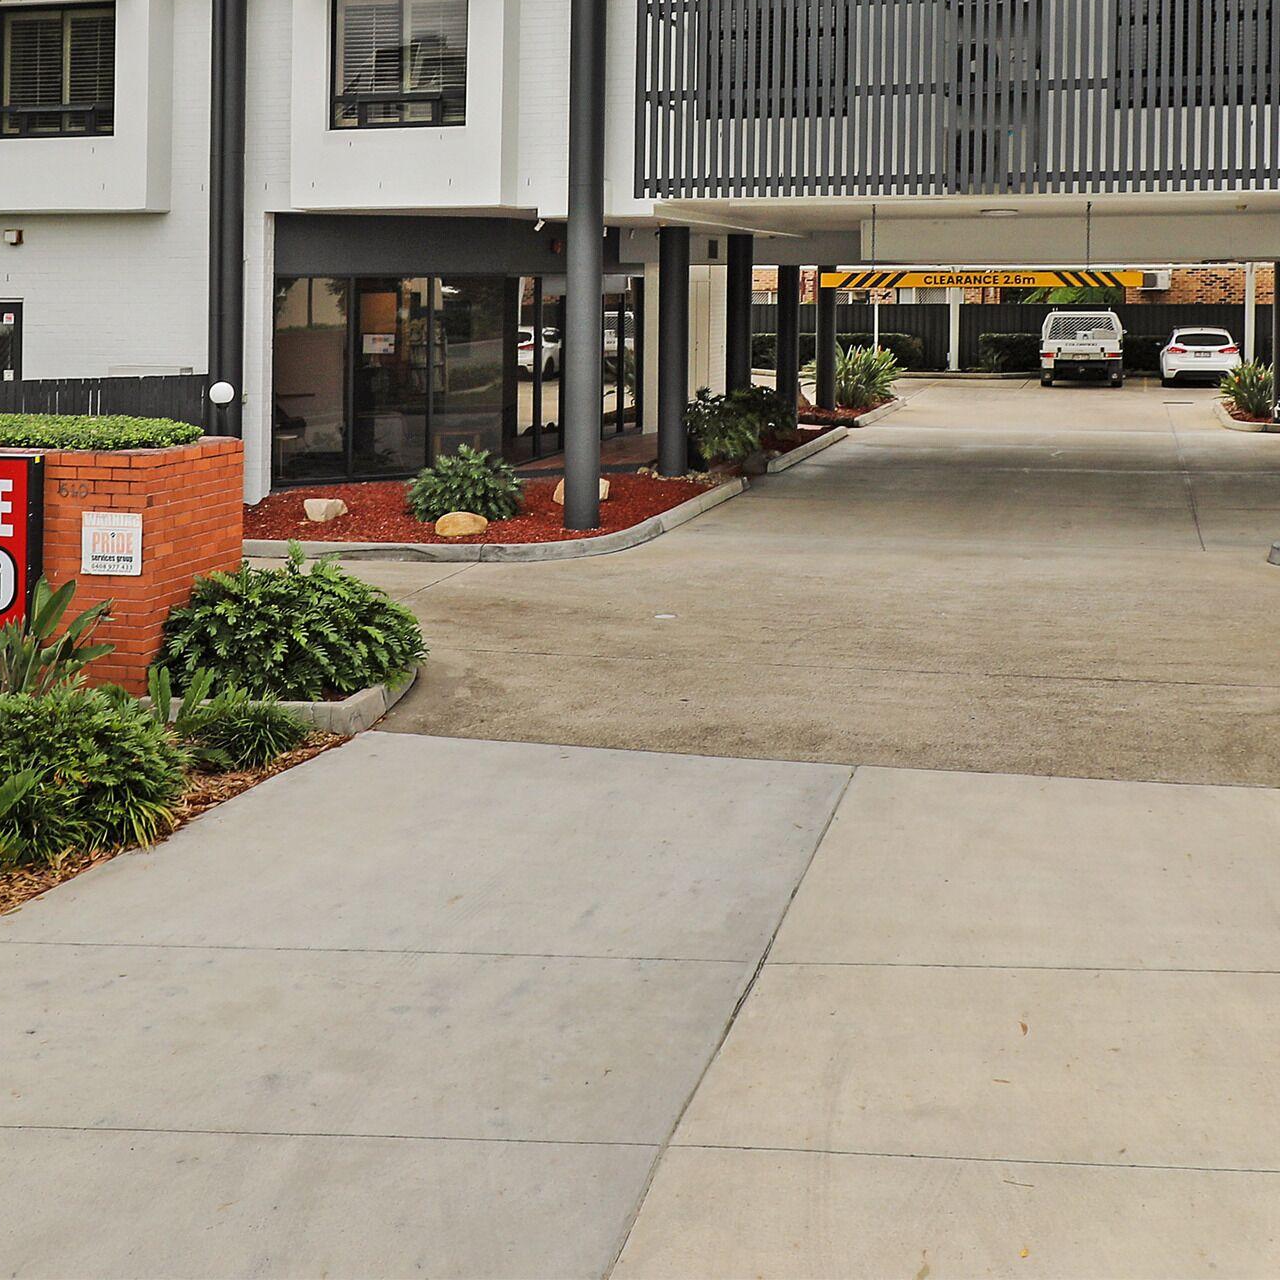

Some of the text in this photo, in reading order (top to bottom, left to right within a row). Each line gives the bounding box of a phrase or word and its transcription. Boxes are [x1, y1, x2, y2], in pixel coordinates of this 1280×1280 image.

[923, 275, 1036, 285] CLEARANCE 2.6m
[91, 553, 116, 562] services
